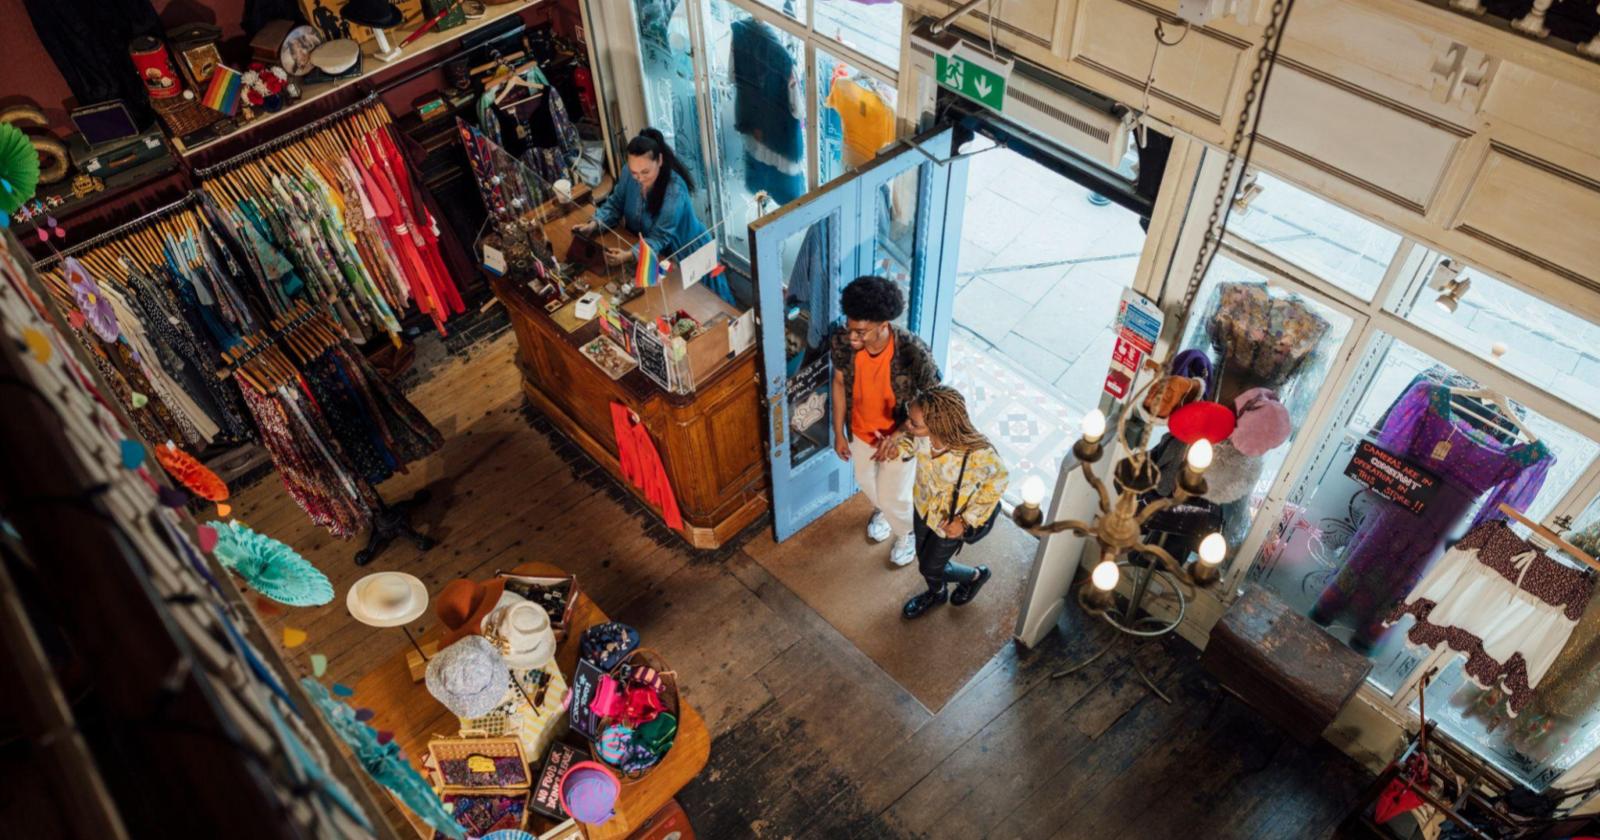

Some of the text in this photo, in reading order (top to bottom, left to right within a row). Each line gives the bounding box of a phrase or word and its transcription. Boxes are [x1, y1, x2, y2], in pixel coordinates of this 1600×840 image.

[1353, 457, 1394, 485] OPERATION
[1397, 484, 1409, 494] IN
[1358, 469, 1376, 485] THIS
[1363, 443, 1433, 486] CAMERAS ARE IN
[1370, 457, 1422, 490] CONSTANT
[536, 751, 562, 803] NO FOOD OR
